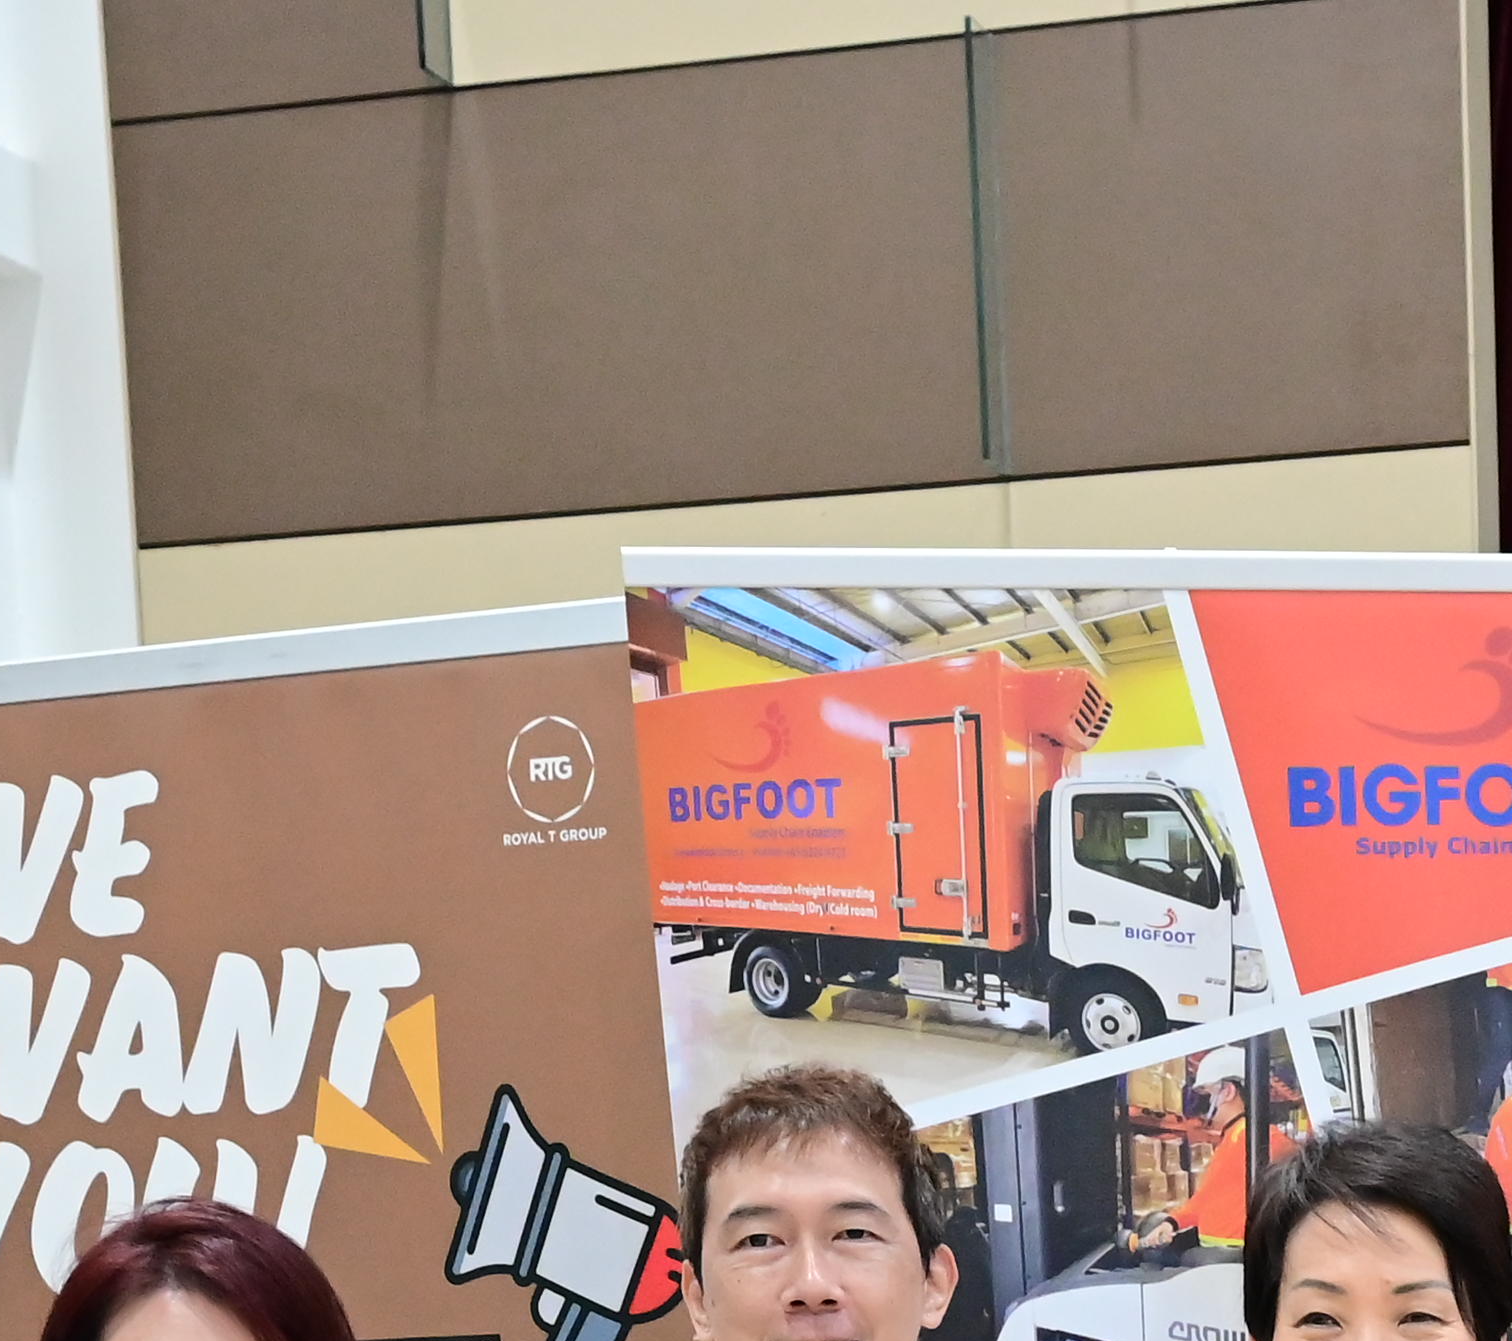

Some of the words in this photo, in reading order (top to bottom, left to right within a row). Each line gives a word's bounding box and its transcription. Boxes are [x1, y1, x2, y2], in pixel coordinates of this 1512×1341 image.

[529, 755, 573, 783] RTG
[669, 778, 842, 822] BIGFOOT
[503, 831, 545, 846] ROYAL
[548, 830, 556, 843] T
[559, 826, 607, 842] GROUP
[1355, 836, 1436, 859] Supply
[827, 886, 875, 901] Forwarding
[1125, 927, 1196, 944] BIGFOOT
